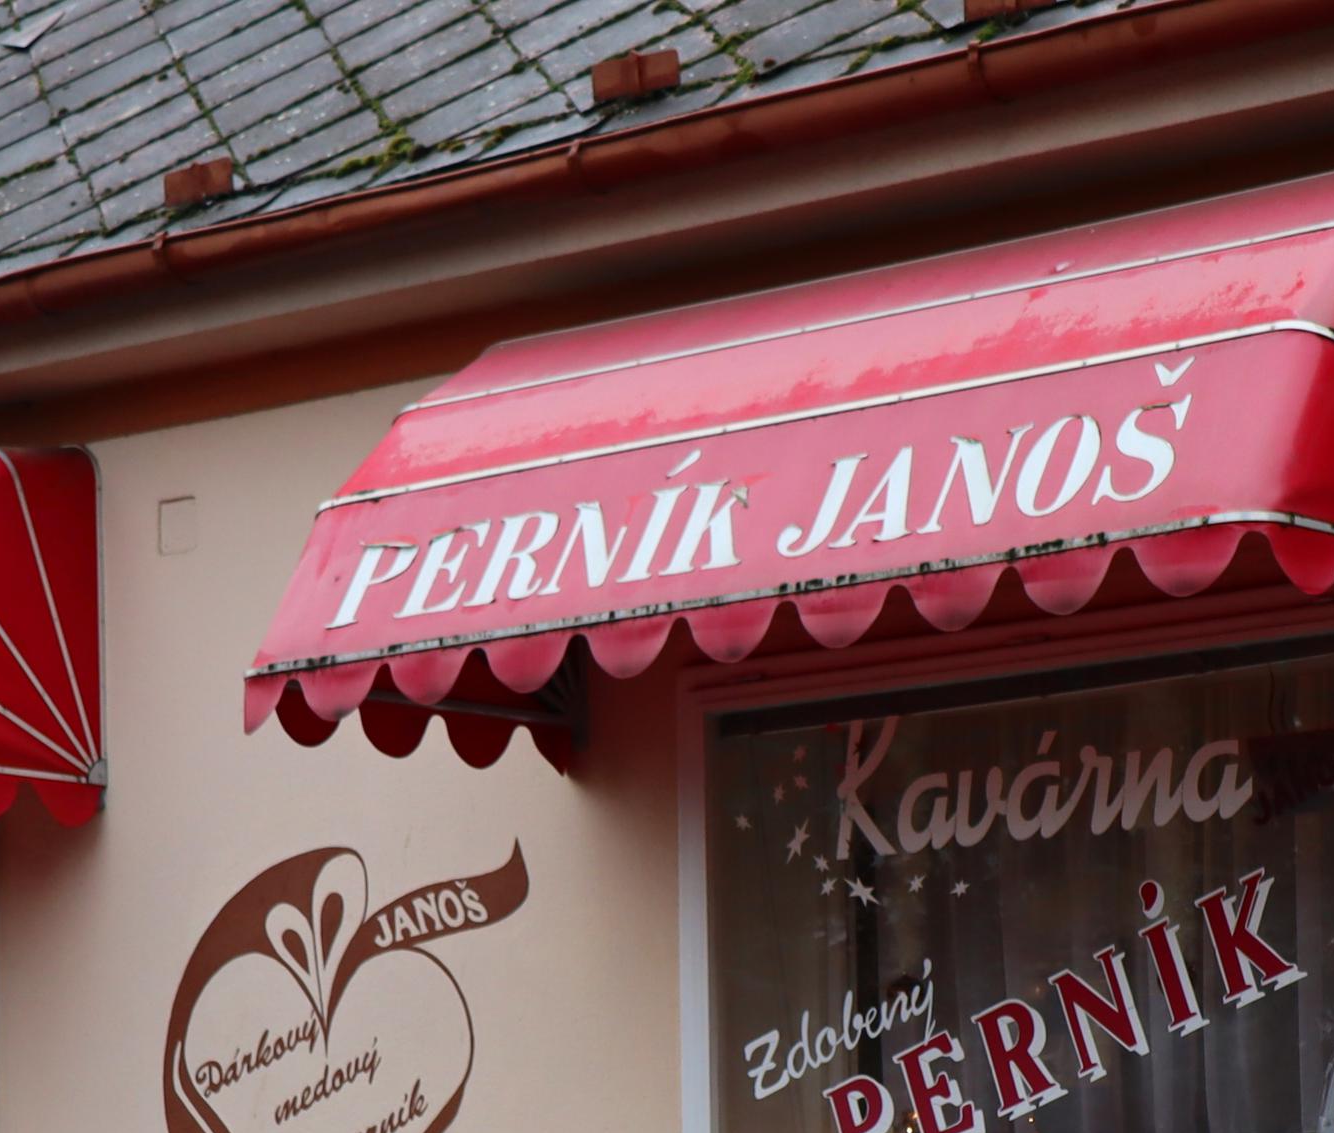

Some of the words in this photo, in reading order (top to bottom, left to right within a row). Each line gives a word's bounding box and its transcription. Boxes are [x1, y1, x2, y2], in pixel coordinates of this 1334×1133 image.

[324, 448, 750, 630] PERNÍK
[775, 355, 1197, 559] JANOŠ
[835, 713, 1254, 861] Kavárna
[373, 879, 489, 949] JANOŠ
[195, 1012, 321, 1099] Dárkový
[273, 1035, 383, 1126] medový
[743, 957, 934, 1101] Zdobený
